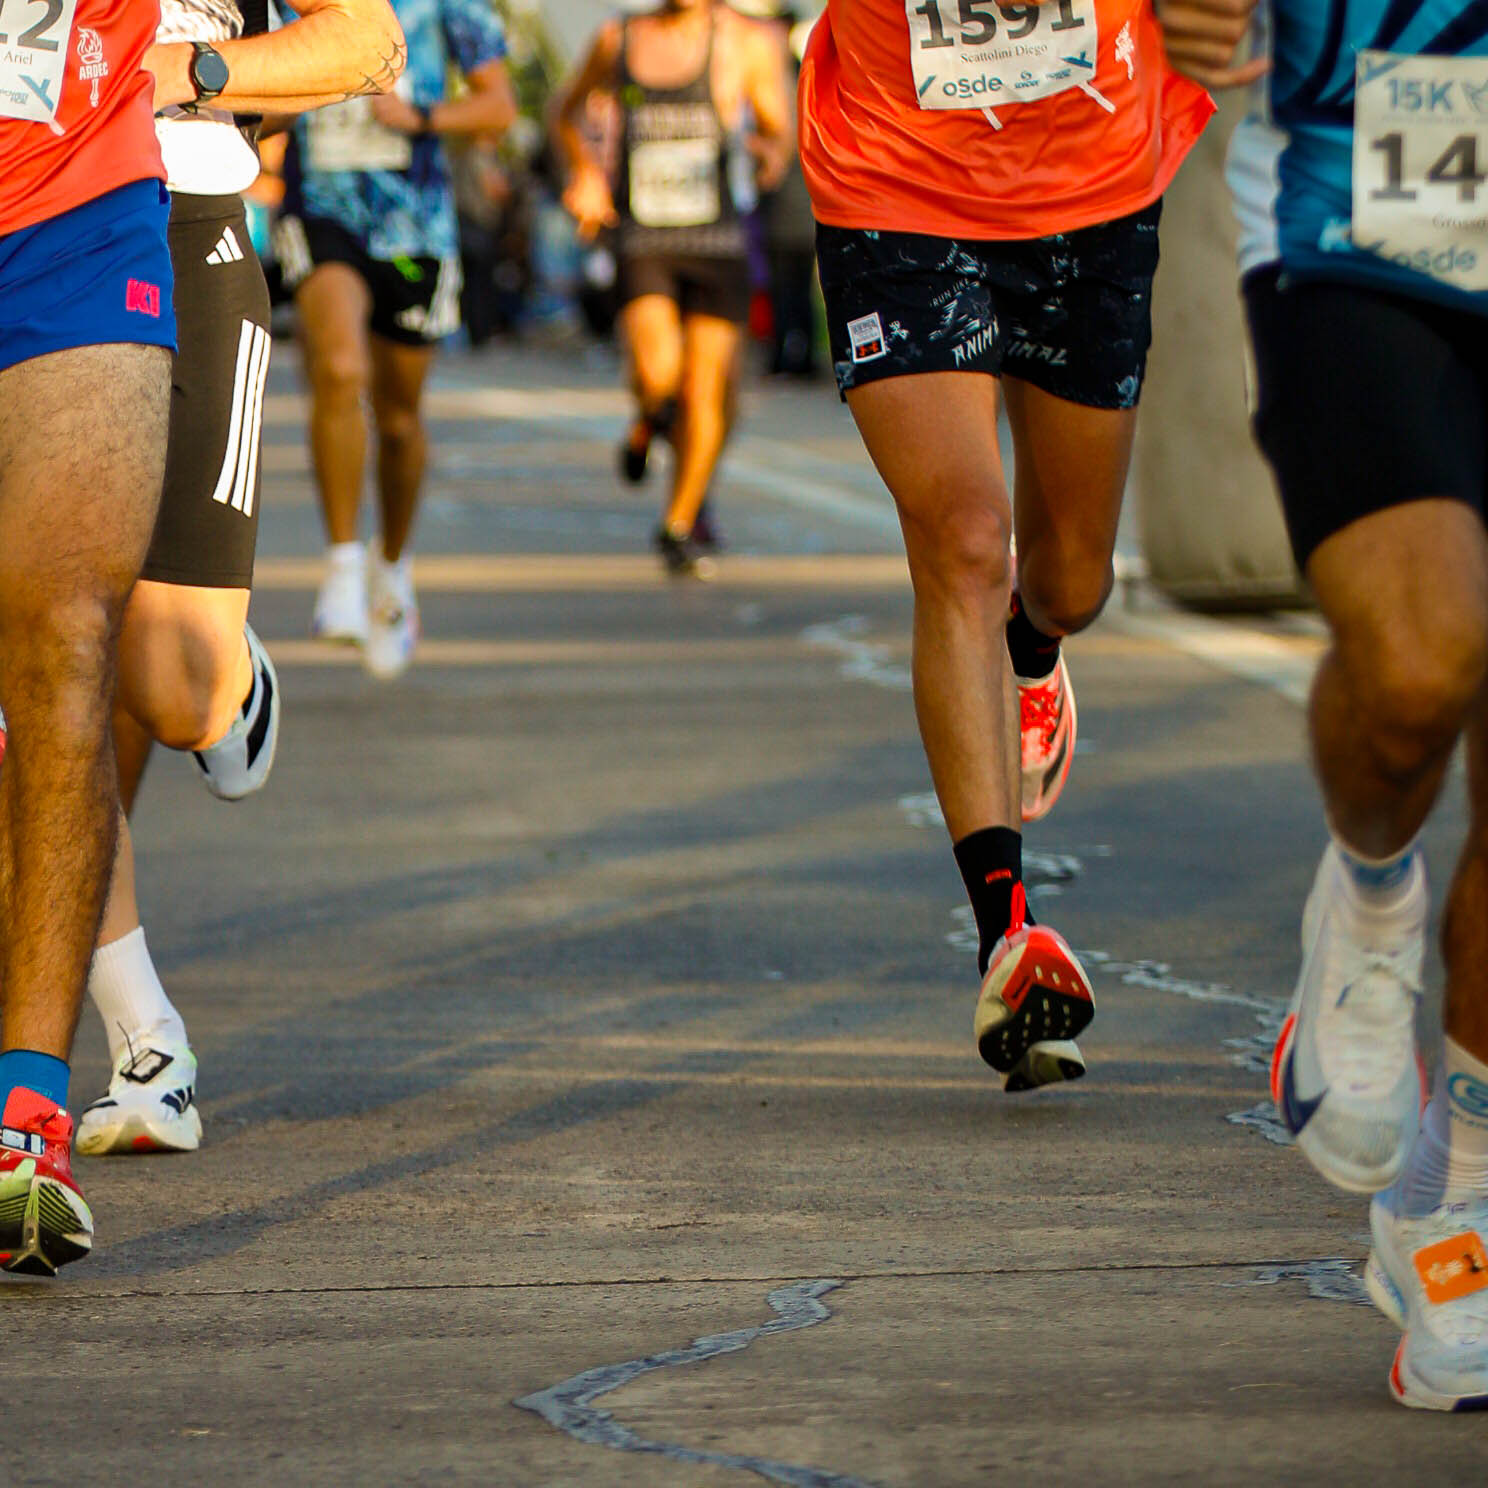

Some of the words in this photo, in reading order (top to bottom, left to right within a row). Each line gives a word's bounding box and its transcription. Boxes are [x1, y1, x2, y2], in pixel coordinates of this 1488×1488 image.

[3, 51, 33, 65] Ariel
[960, 47, 1012, 63] Scattolini
[1015, 43, 1048, 57] Diego
[943, 73, 1003, 98] osde
[1386, 79, 1454, 111] 15K
